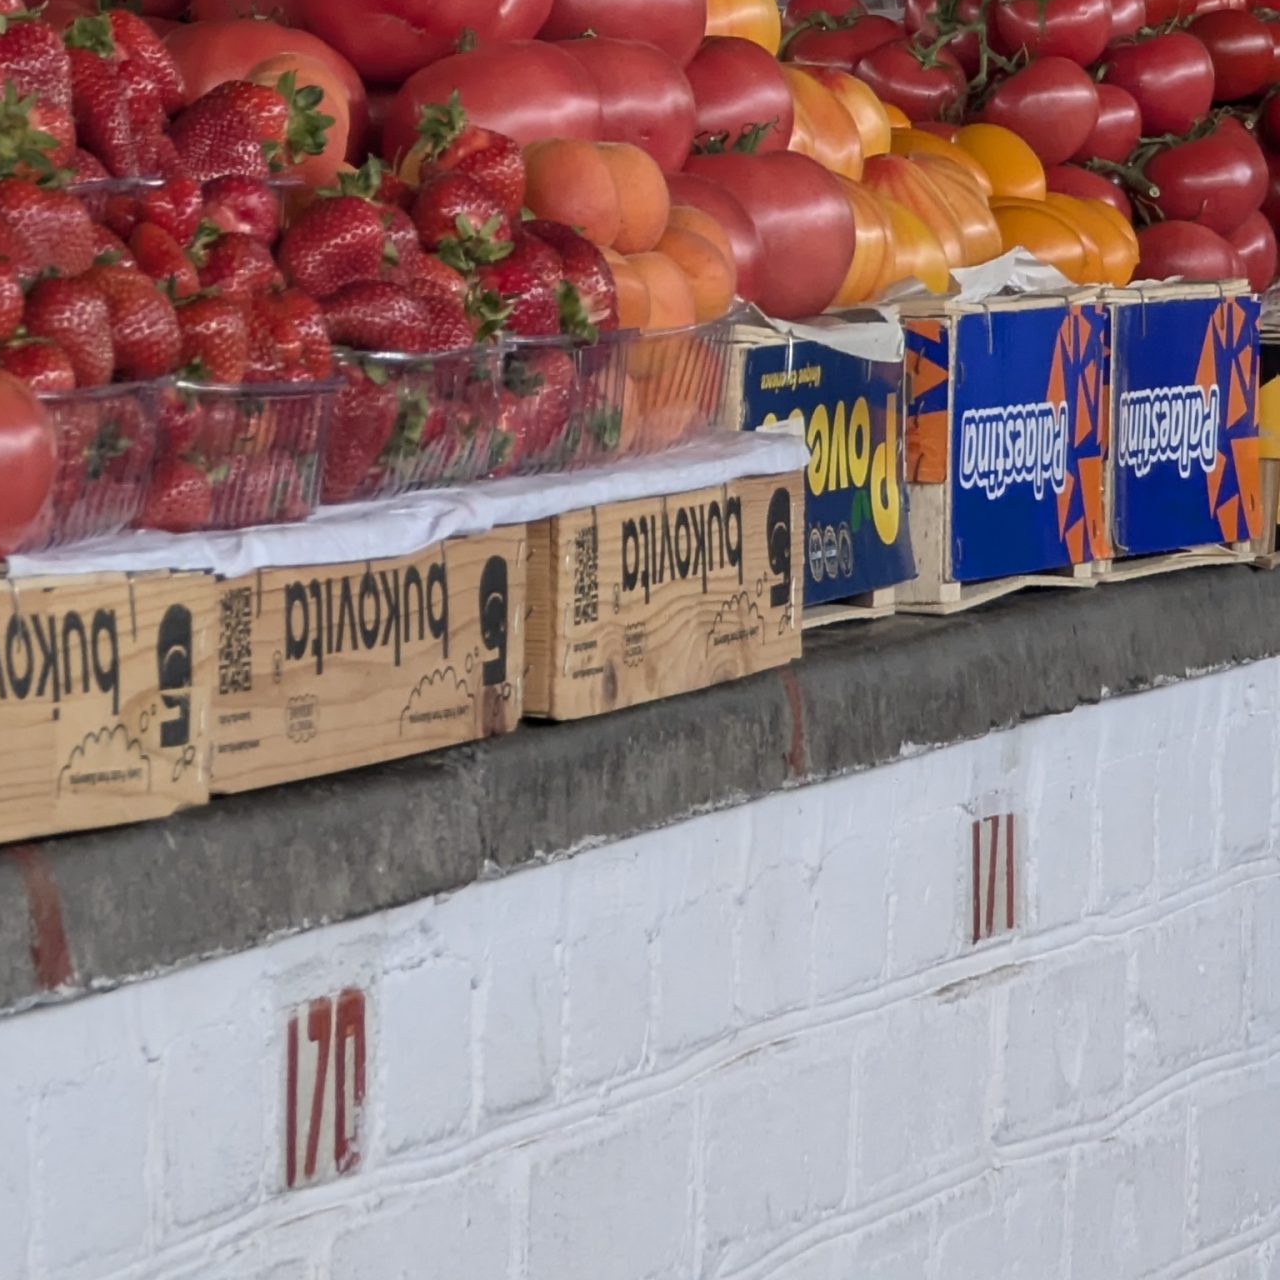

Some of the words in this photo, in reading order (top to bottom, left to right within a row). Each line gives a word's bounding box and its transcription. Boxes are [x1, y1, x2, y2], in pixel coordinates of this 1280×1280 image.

[763, 392, 899, 545] Pove
[960, 402, 1068, 499] Palaestina
[1119, 384, 1219, 478] Palaestina
[622, 495, 743, 605] bukovita
[285, 562, 449, 675] bukovita
[971, 813, 1014, 945] 171
